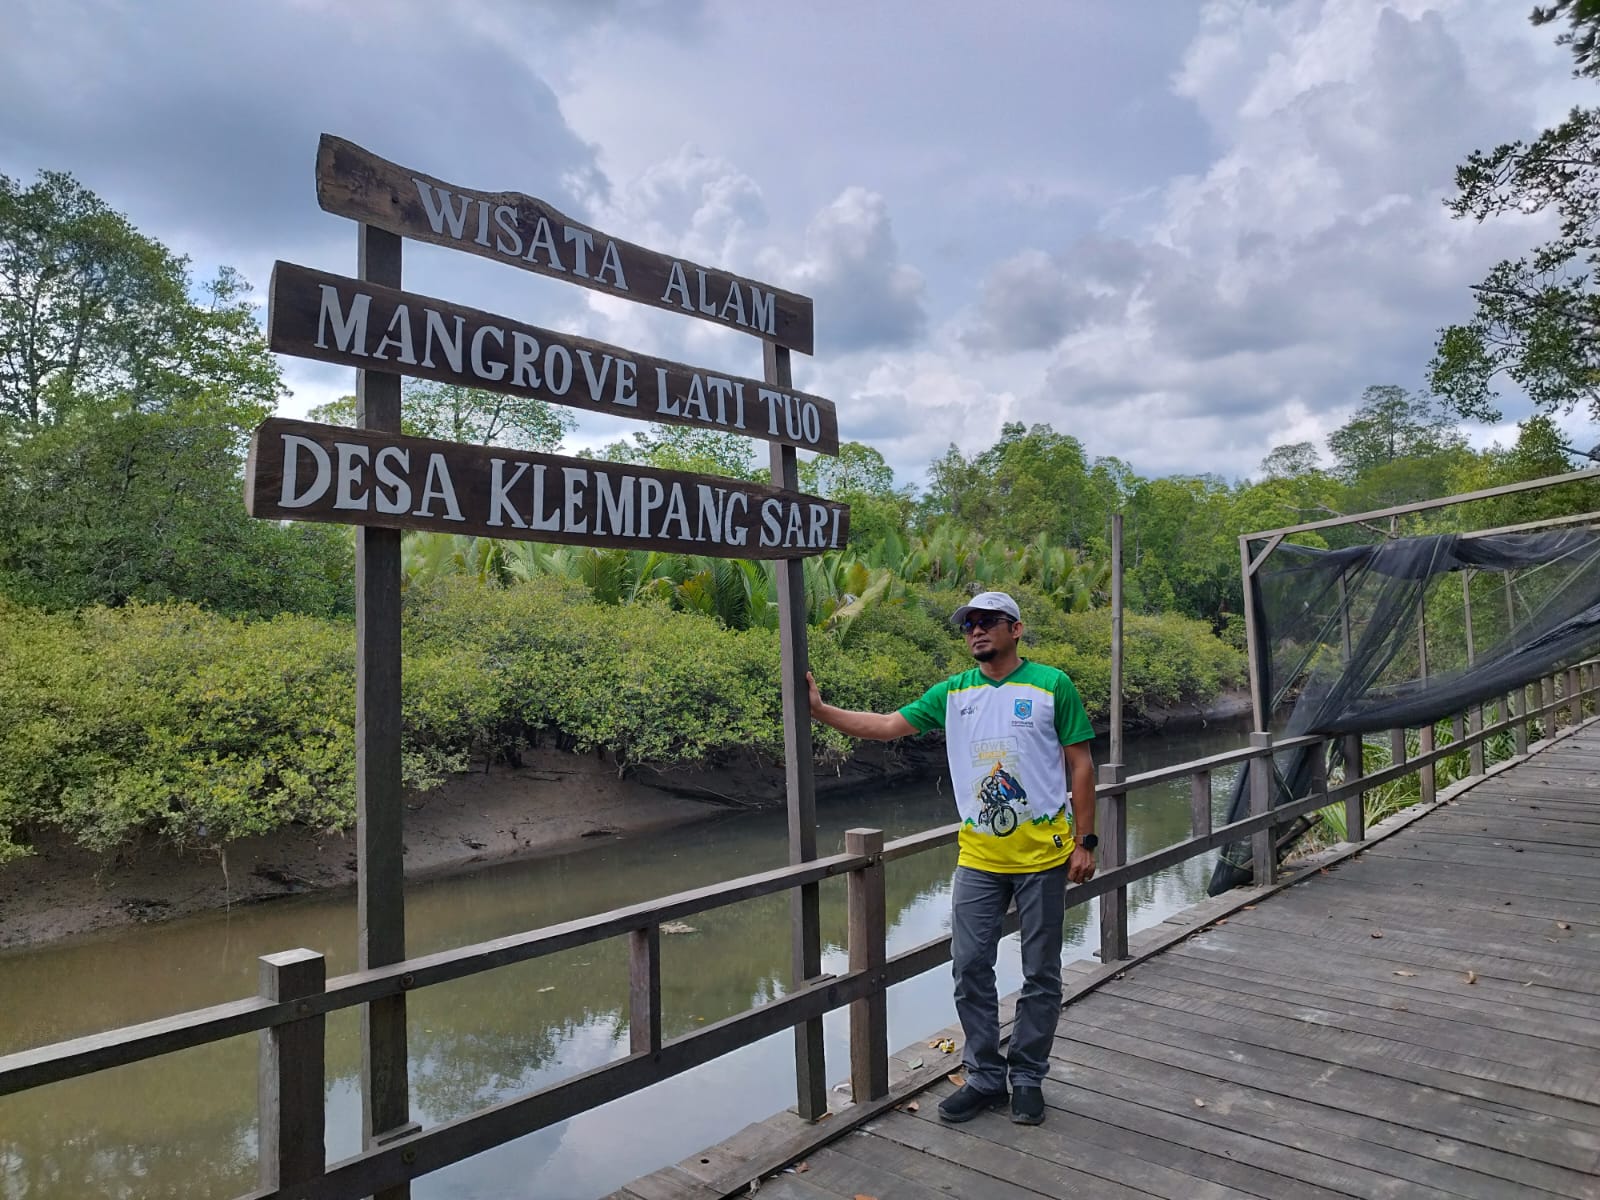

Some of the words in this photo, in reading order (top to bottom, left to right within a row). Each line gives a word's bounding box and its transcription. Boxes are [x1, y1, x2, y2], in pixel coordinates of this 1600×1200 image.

[413, 179, 628, 290] WISATA
[661, 262, 777, 335] ALAM
[314, 284, 637, 407] MANGROVE
[655, 368, 746, 429] LATI
[759, 388, 820, 444] TUO
[277, 434, 465, 522] DESA
[487, 458, 748, 546] KLEMPANG
[760, 499, 841, 548] SARI
